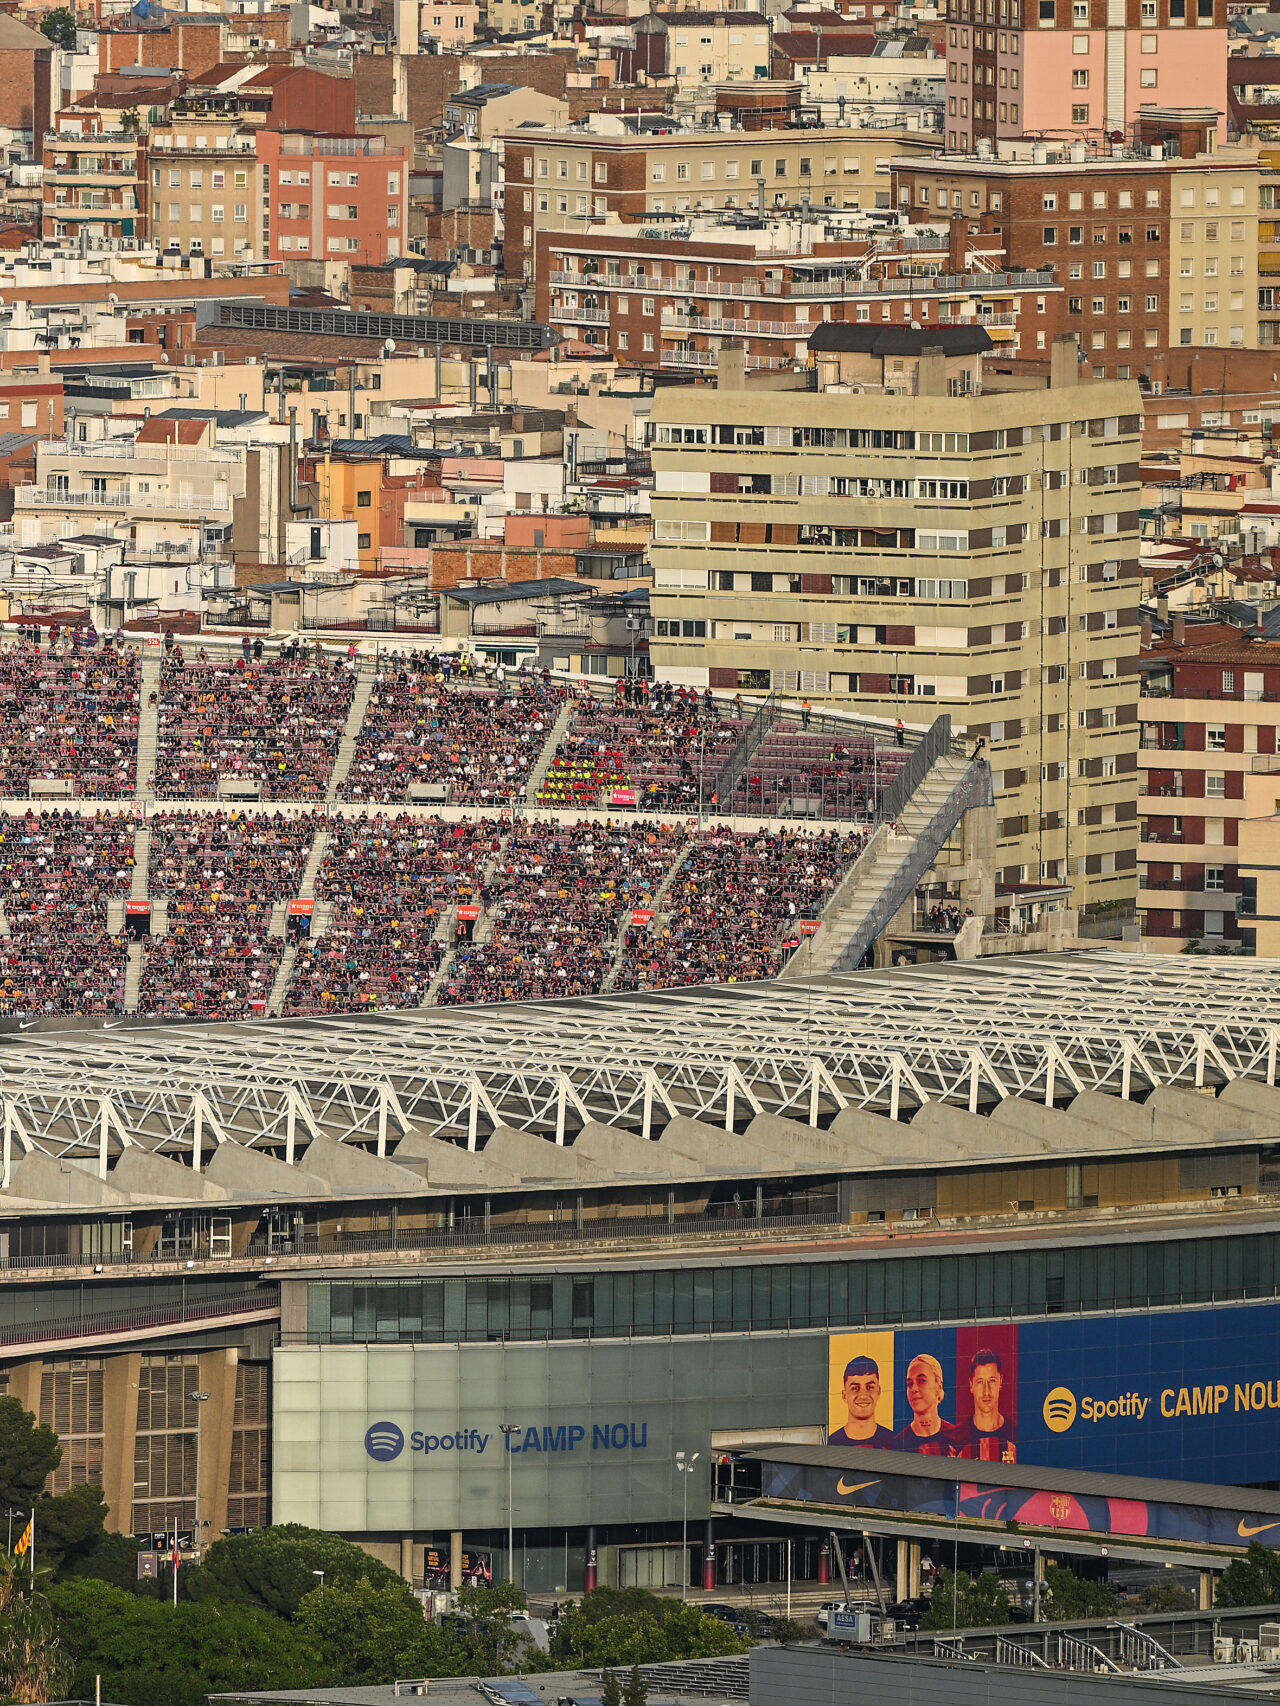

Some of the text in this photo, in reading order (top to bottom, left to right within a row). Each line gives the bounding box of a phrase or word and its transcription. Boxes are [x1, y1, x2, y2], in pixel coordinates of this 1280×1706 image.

[1081, 1380, 1280, 1422] Spotify CAMP NOU
[410, 1423, 648, 1454] Spotify CAMP NOU
[836, 1615, 854, 1623] AESA
